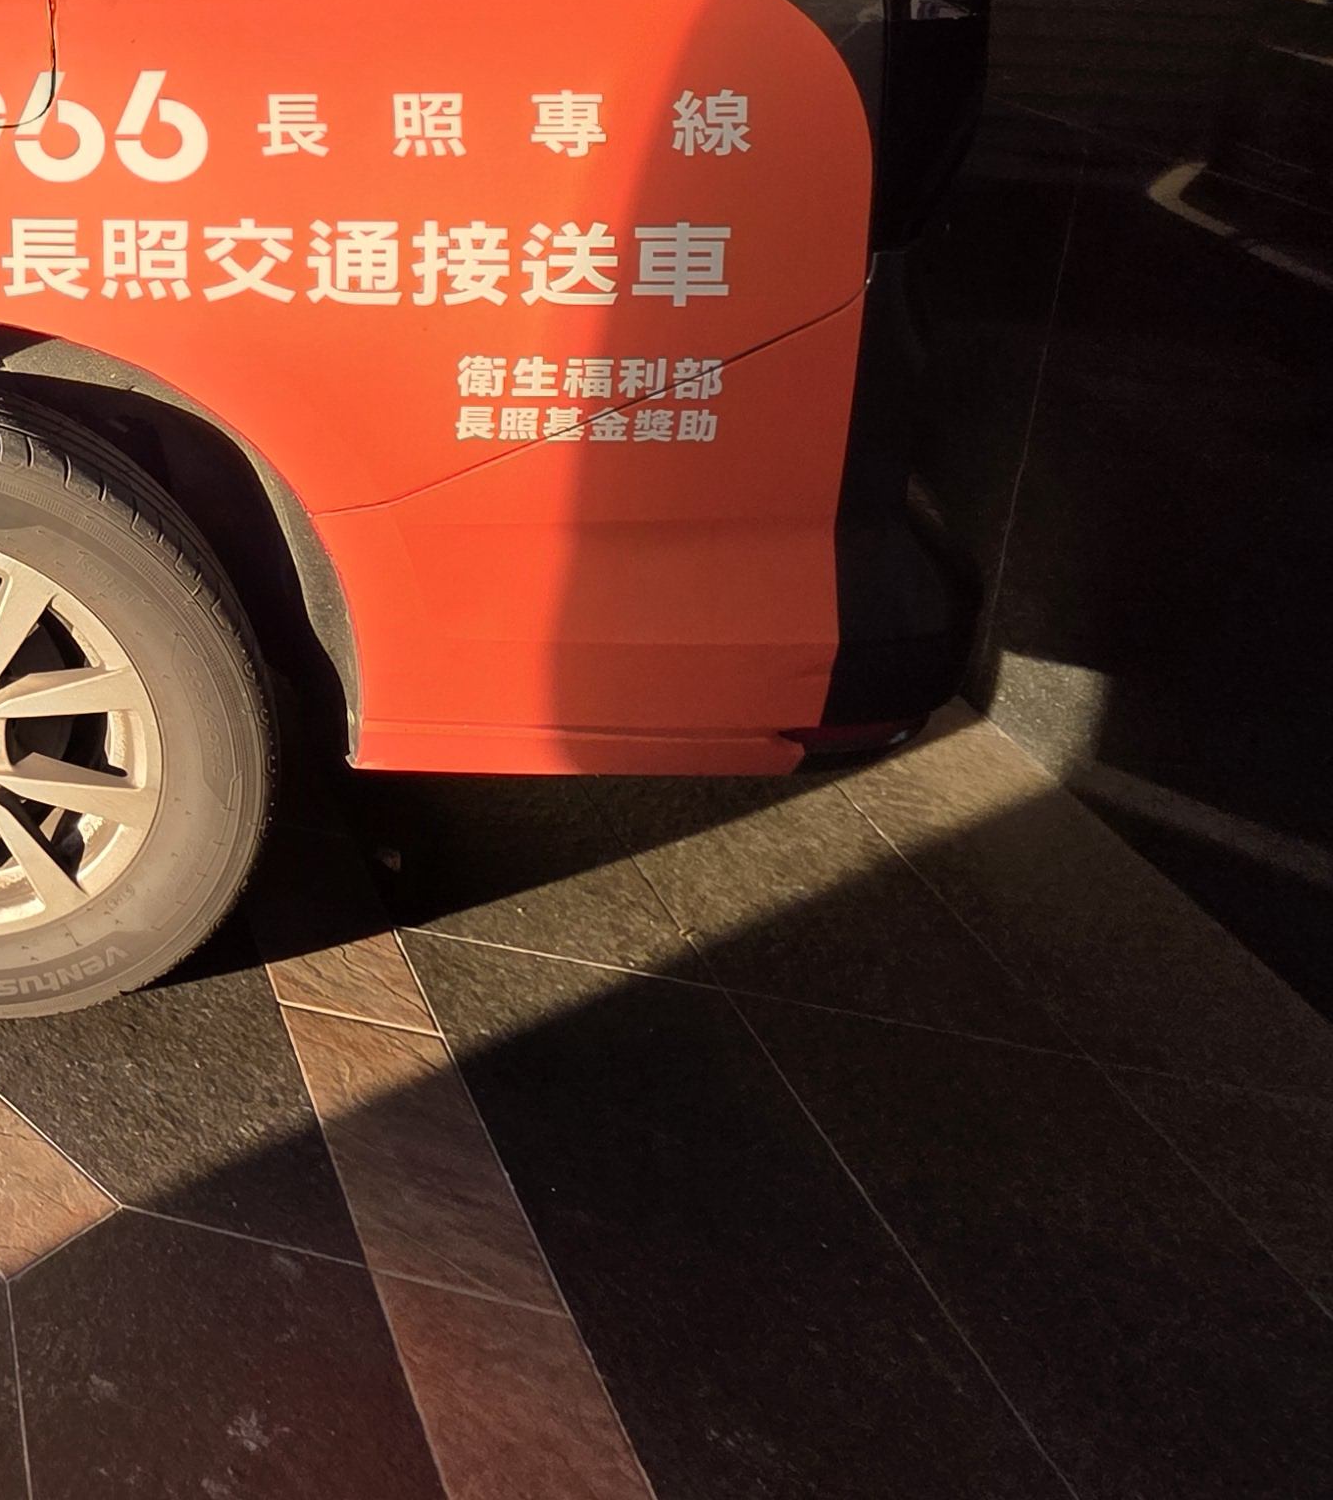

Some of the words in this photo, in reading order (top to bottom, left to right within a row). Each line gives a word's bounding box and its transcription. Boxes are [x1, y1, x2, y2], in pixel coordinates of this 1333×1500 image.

[257, 88, 753, 159] 長照專線
[0, 216, 732, 308] 長照交通接送車
[456, 354, 724, 400] 衛生福利部
[455, 405, 719, 442] 長照基金獎助
